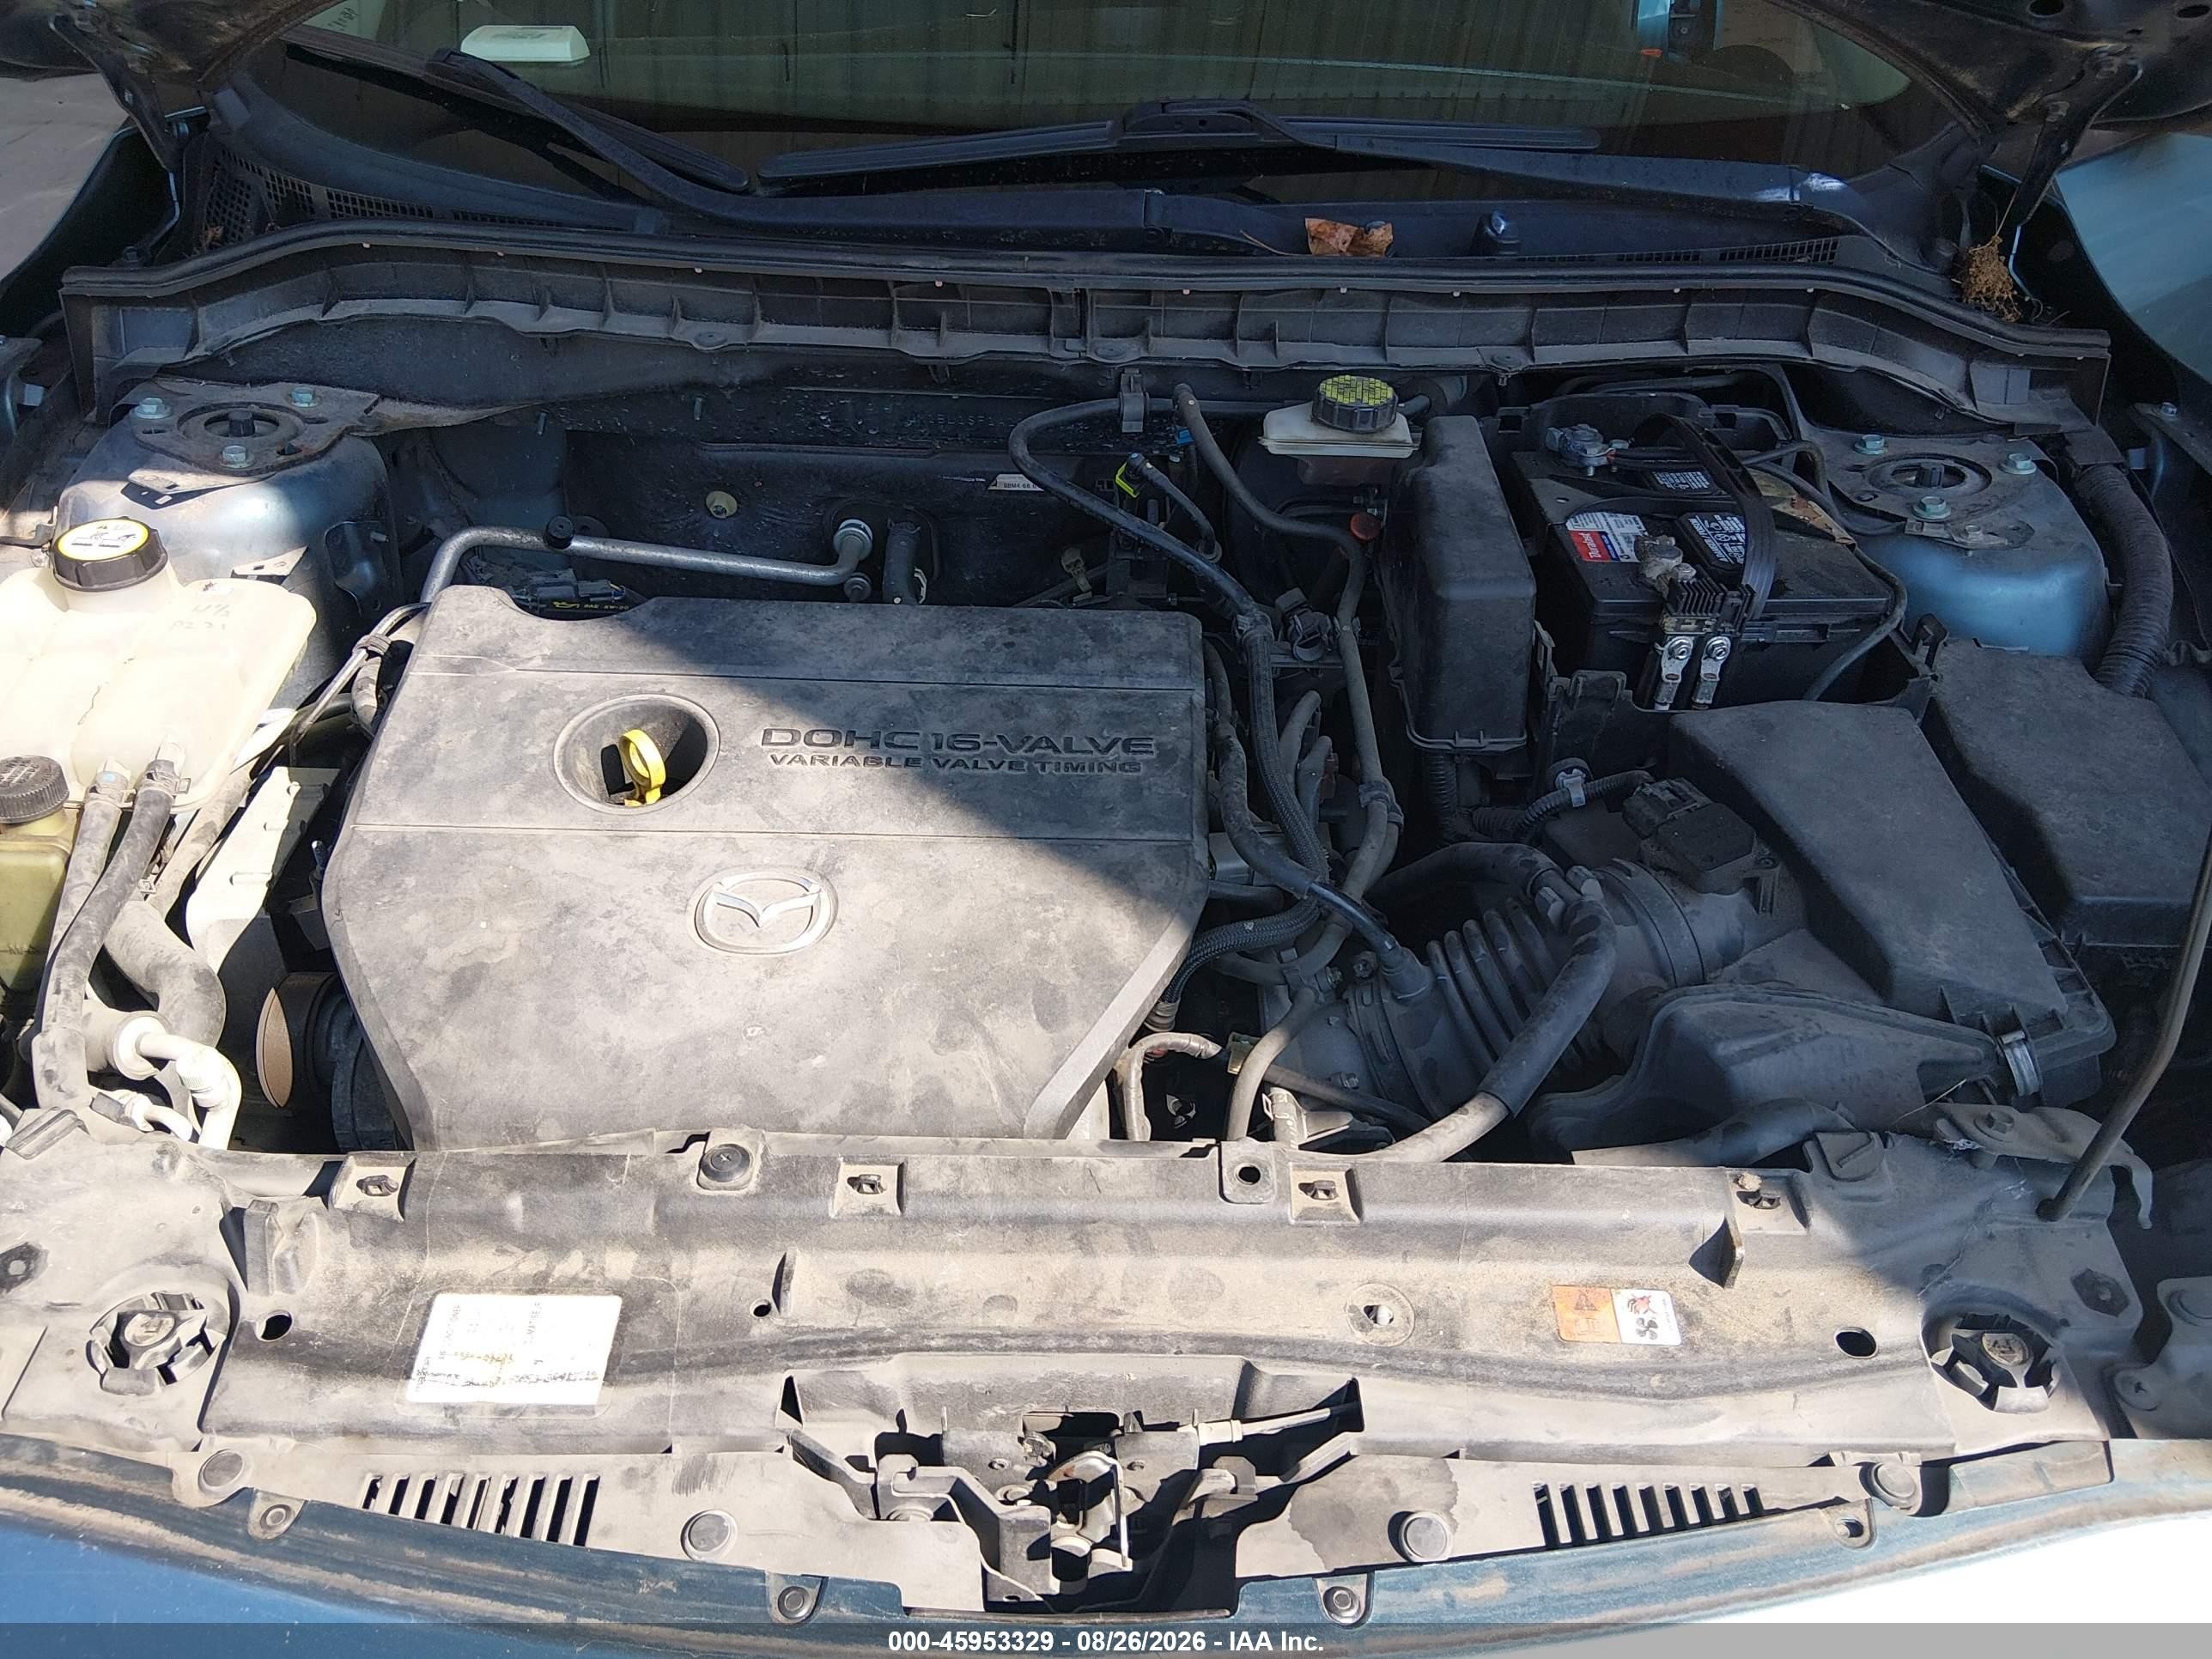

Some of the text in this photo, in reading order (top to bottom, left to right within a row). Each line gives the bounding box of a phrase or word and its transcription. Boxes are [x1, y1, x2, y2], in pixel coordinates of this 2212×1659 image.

[1578, 532, 1602, 559] Duralast
[761, 728, 1155, 756] DOHC 16-VALVE
[769, 754, 1142, 774] VARIABLE VALVE TIMING
